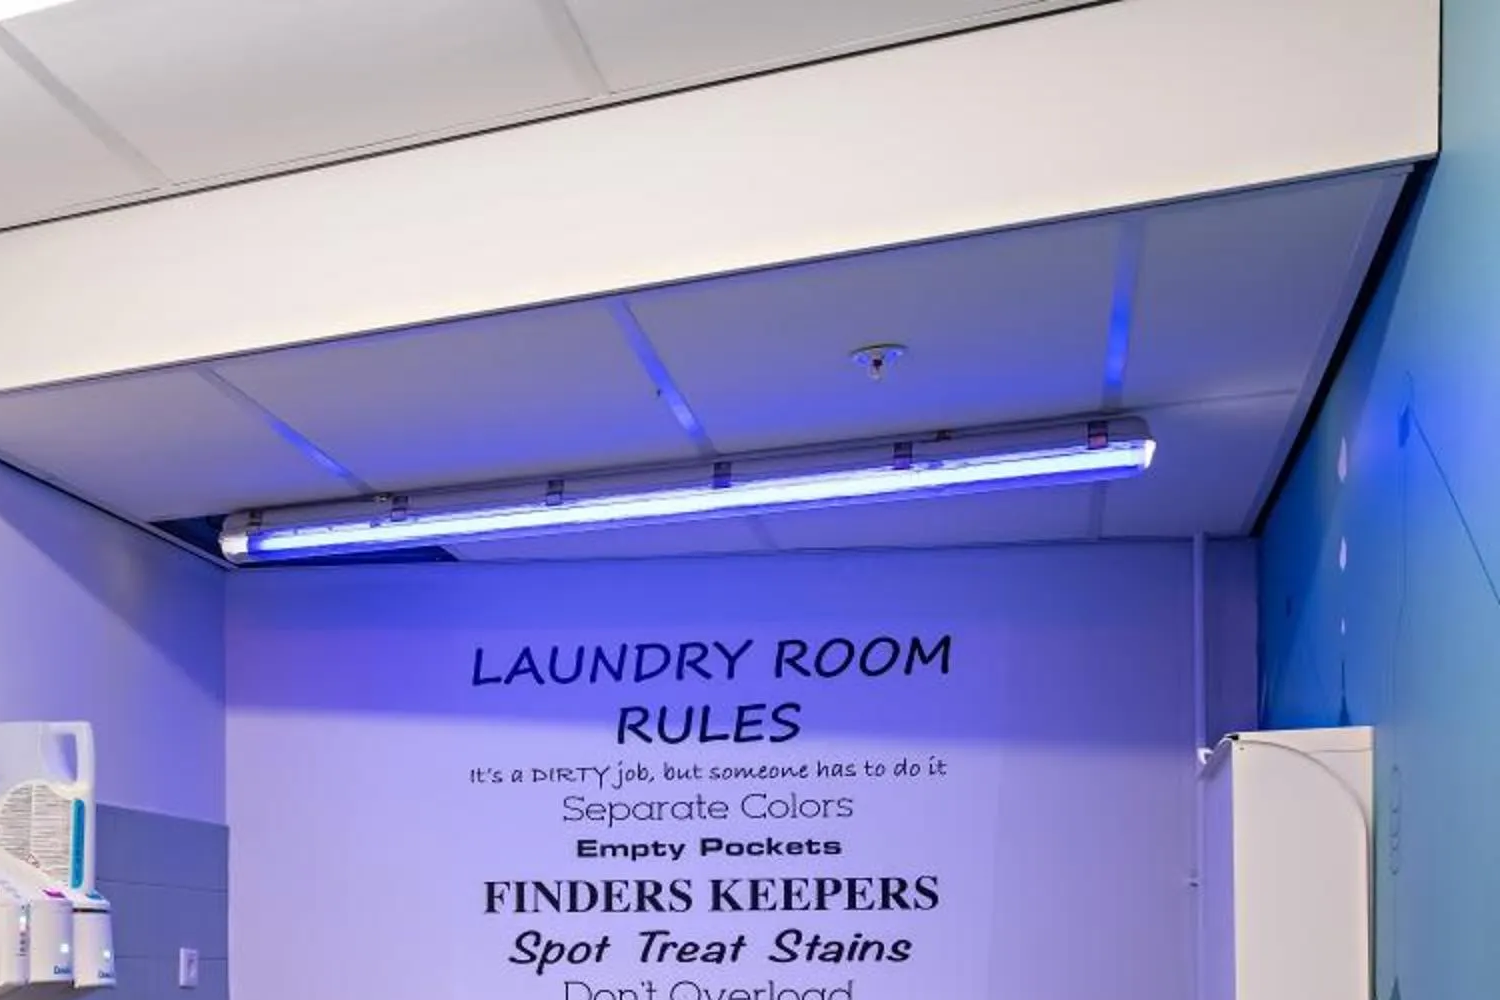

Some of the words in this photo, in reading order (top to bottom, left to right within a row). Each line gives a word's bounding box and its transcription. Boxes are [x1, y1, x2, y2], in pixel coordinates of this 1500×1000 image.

[472, 639, 753, 686] LAUNDRY
[775, 635, 951, 678] ROOM
[618, 702, 800, 744] RULES
[470, 768, 503, 783] It's
[511, 770, 523, 783] a
[532, 766, 610, 790] DIRTY
[612, 760, 655, 790] job,
[661, 762, 702, 781] but
[709, 765, 808, 780] someone
[817, 760, 856, 778] has
[864, 760, 886, 777] to
[894, 758, 921, 777] do
[929, 756, 947, 776] it
[563, 793, 729, 828] Separate
[740, 792, 853, 819] Colors
[577, 840, 686, 862] Empty
[700, 837, 842, 856] Pockets
[484, 879, 692, 913] FINDERS
[710, 875, 938, 912] KEEPERS
[508, 930, 611, 976] Spot
[639, 930, 747, 964] Treat
[768, 928, 912, 964] Stains
